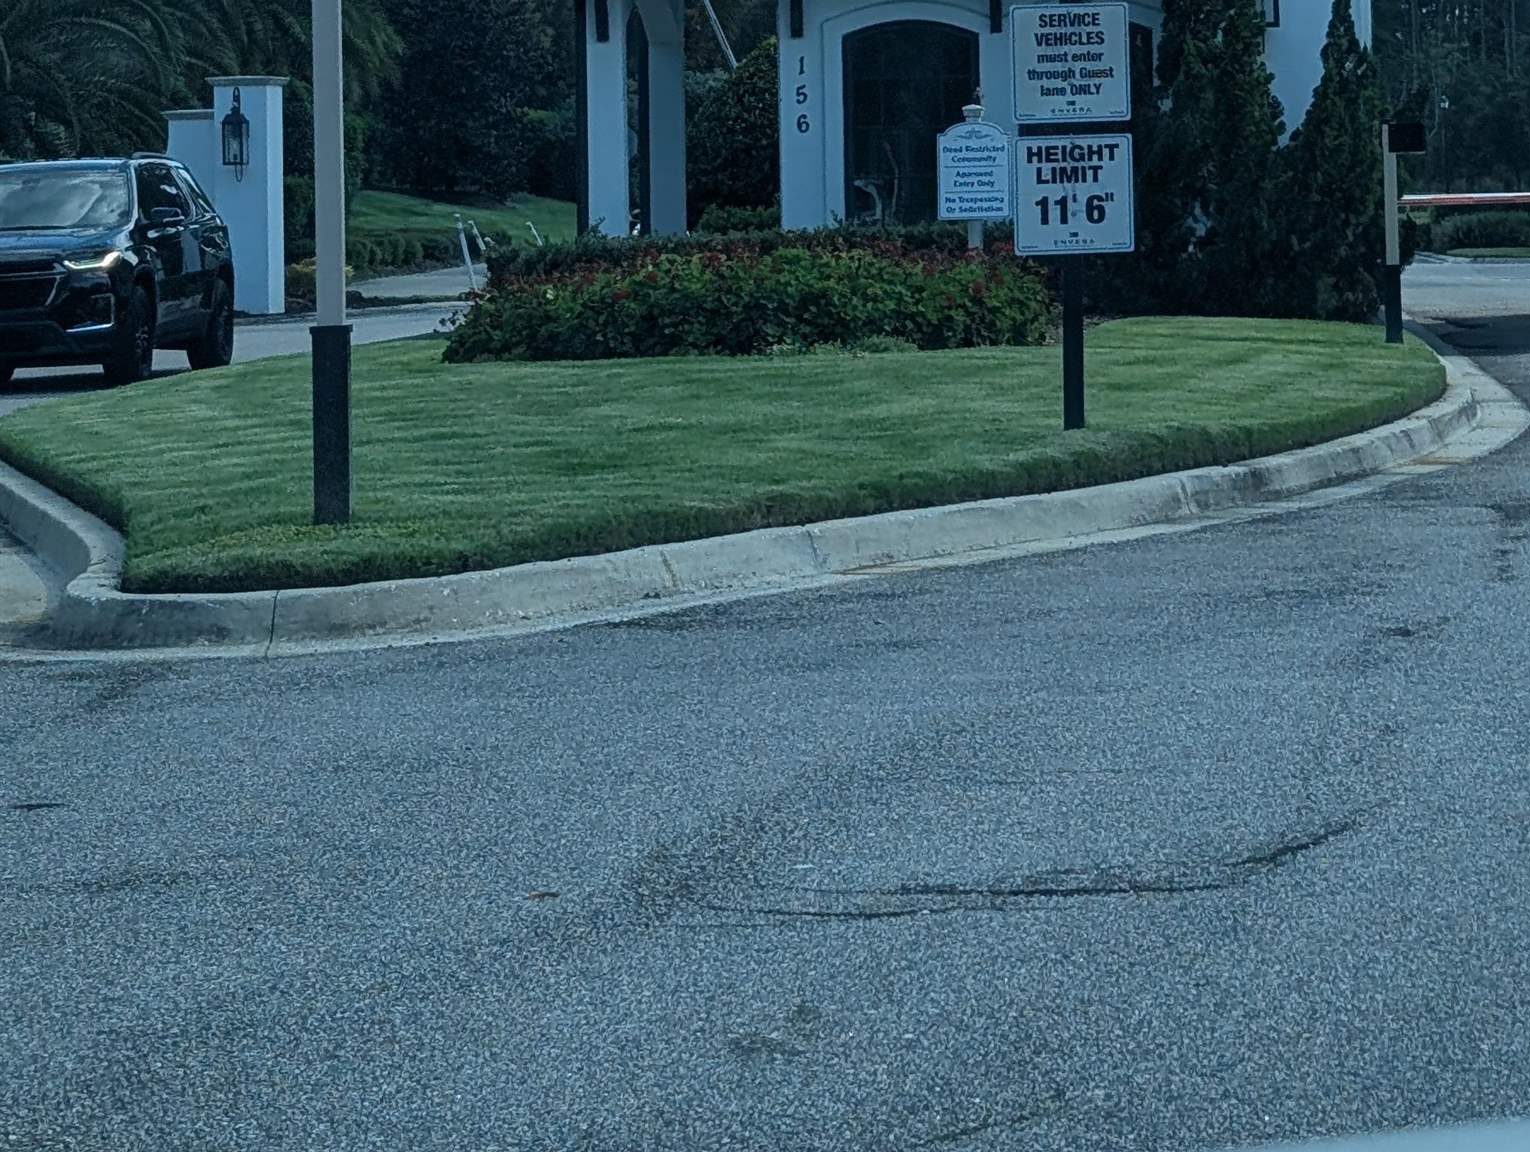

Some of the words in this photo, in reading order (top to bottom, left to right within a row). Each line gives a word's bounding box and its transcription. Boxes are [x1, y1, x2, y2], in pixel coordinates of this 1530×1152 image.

[1038, 12, 1101, 28] SERVICE
[1034, 31, 1105, 47] VEHICLES
[1036, 52, 1068, 64] must
[1071, 51, 1104, 63] enter
[1027, 67, 1075, 82] through
[1079, 66, 1114, 79] Guest
[1040, 84, 1067, 97] lane
[1070, 83, 1102, 96] ONLY
[965, 145, 1006, 153] Restricted
[1026, 143, 1120, 164] HEIGHT
[951, 155, 997, 163] Community
[1035, 165, 1103, 185] LIMIT
[976, 179, 995, 188] Only
